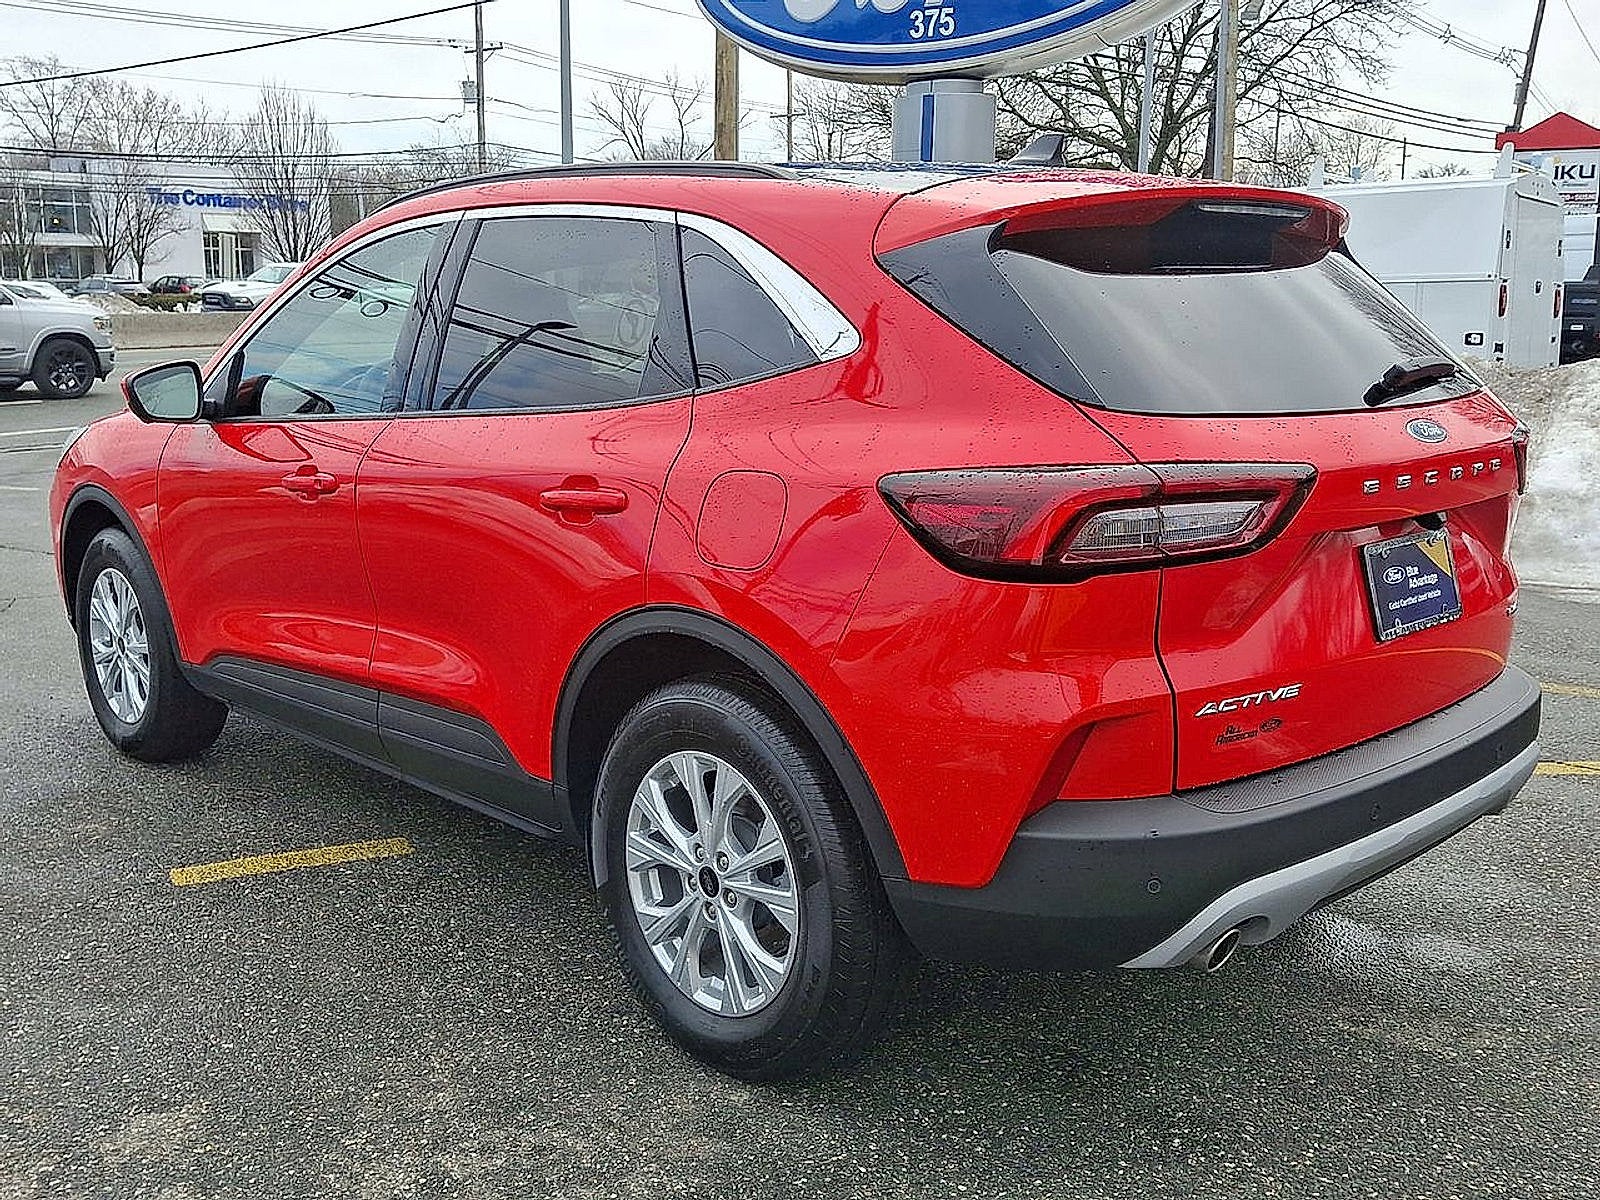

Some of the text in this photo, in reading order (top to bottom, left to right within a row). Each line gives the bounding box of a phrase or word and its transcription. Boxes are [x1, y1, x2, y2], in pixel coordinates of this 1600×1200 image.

[909, 8, 955, 38] 375
[1553, 164, 1596, 180] IKU
[1363, 458, 1501, 495] ESCAPE
[1195, 683, 1303, 717] ACTIVE
